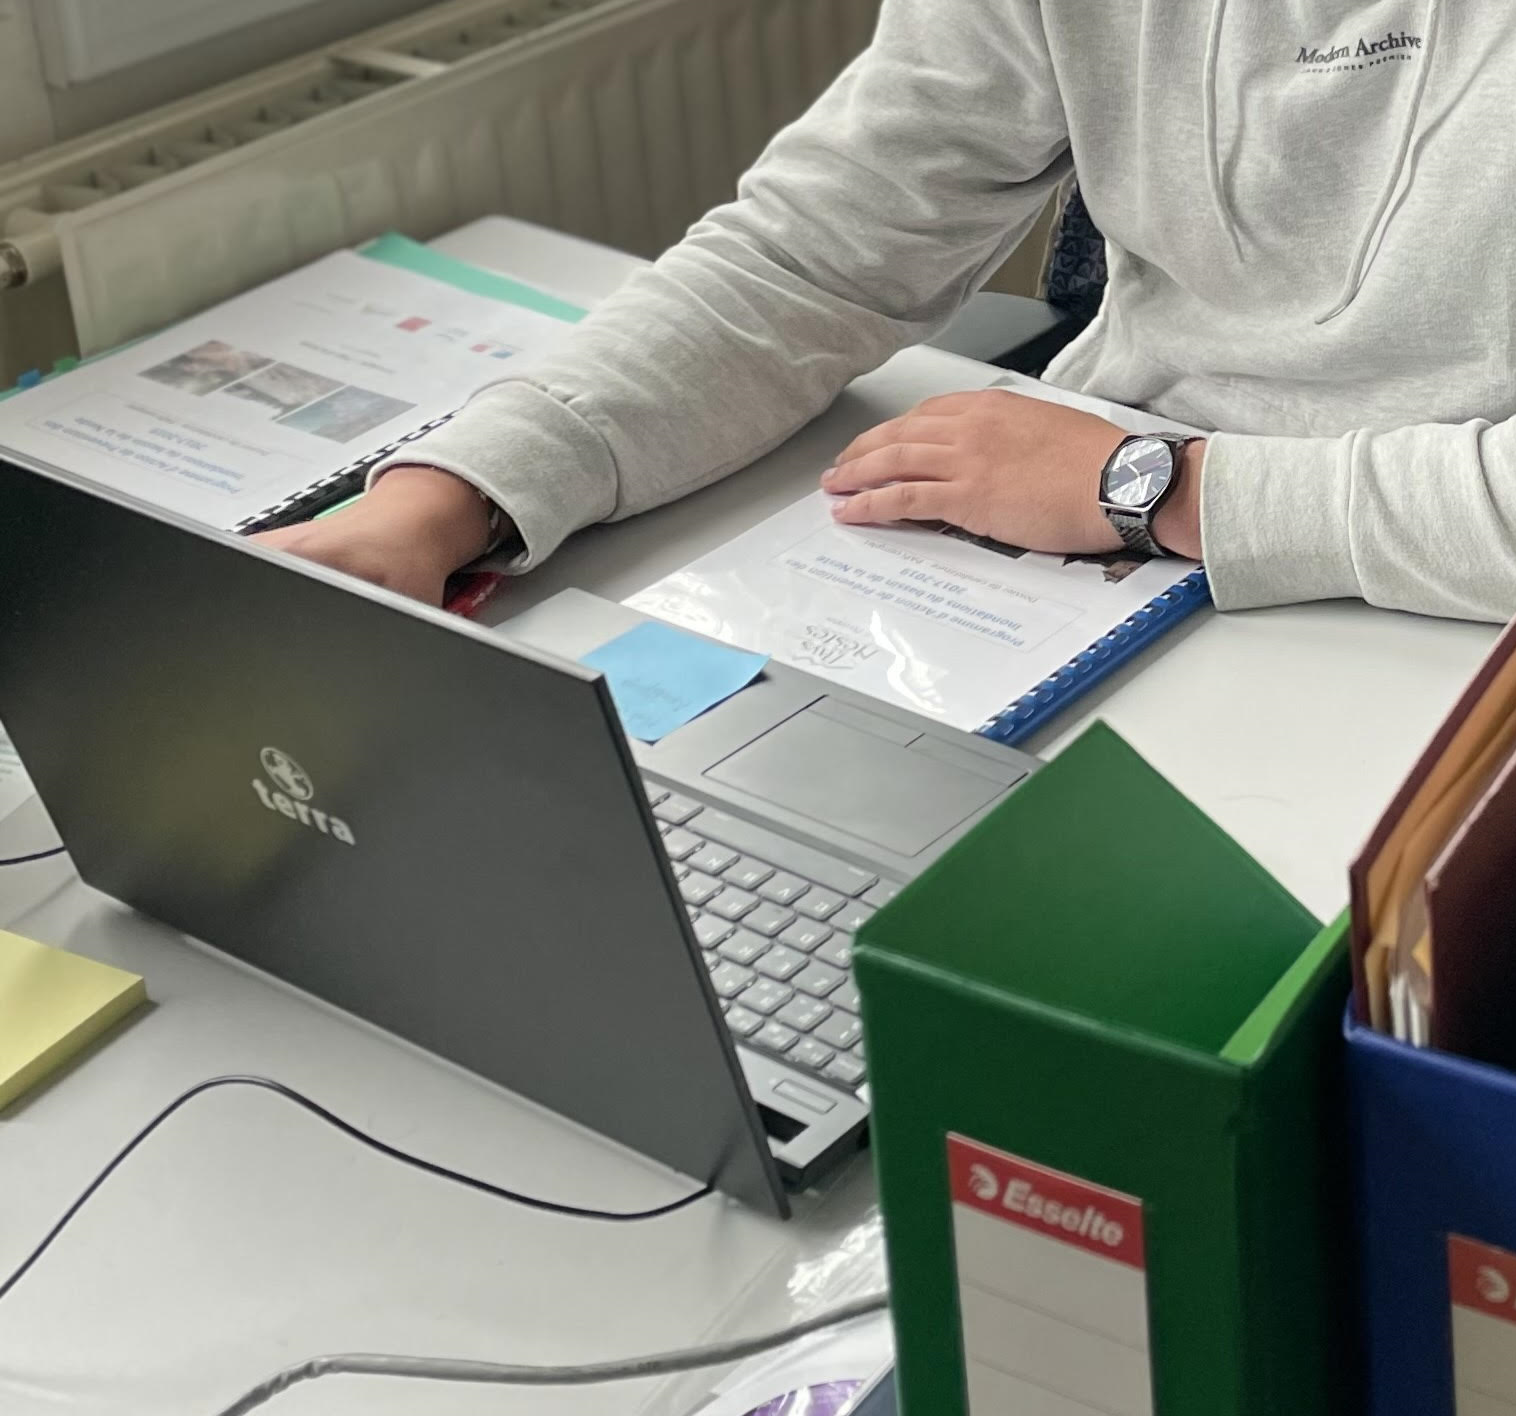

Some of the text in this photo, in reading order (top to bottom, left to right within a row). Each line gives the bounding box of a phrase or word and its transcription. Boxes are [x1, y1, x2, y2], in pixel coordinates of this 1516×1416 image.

[1355, 31, 1423, 58] Archive
[785, 559, 1025, 647] Programme d'Action de Prévention des
[815, 554, 1022, 632] Inondations du bassin de la Neste
[900, 568, 967, 595] 2017-2019
[252, 778, 356, 846] terra
